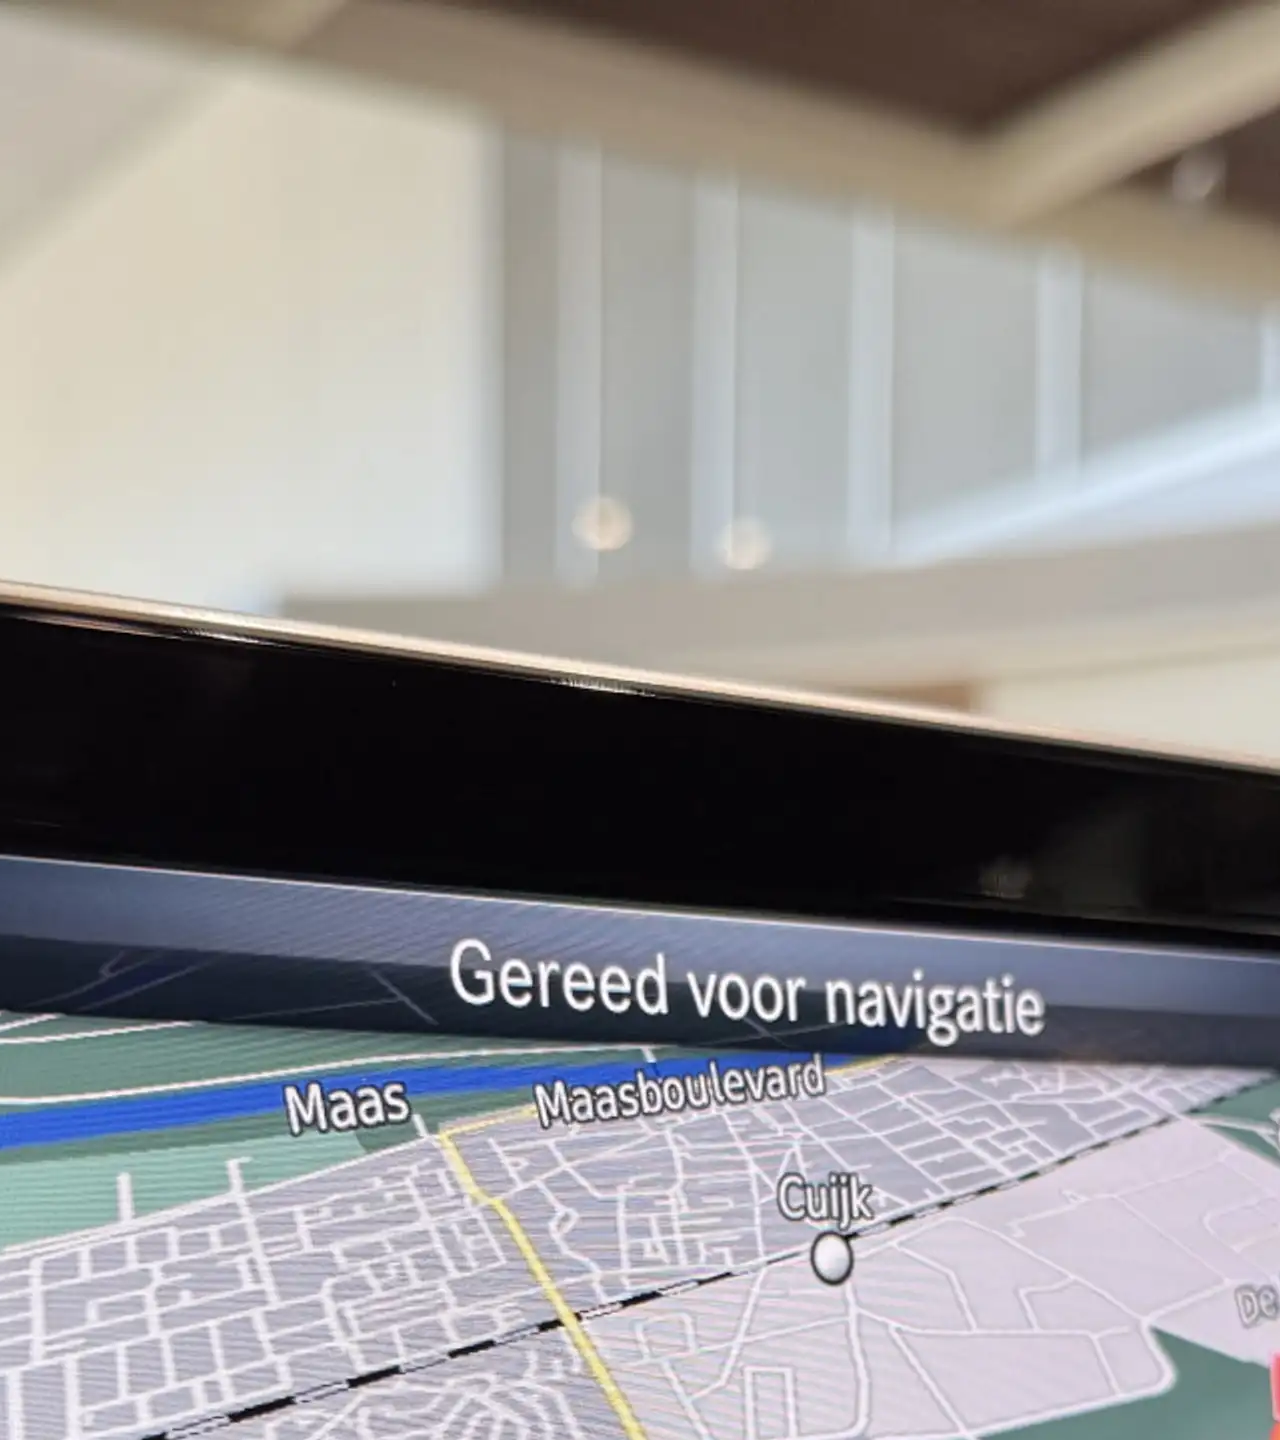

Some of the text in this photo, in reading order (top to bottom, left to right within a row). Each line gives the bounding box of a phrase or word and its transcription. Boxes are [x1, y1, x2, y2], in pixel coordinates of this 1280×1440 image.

[450, 938, 1046, 1046] Gereed voor navigatie
[283, 1079, 410, 1135] Maas
[534, 1055, 826, 1127] Maasboulevard
[777, 1172, 874, 1231] Cuijk
[1235, 1282, 1278, 1329] De
